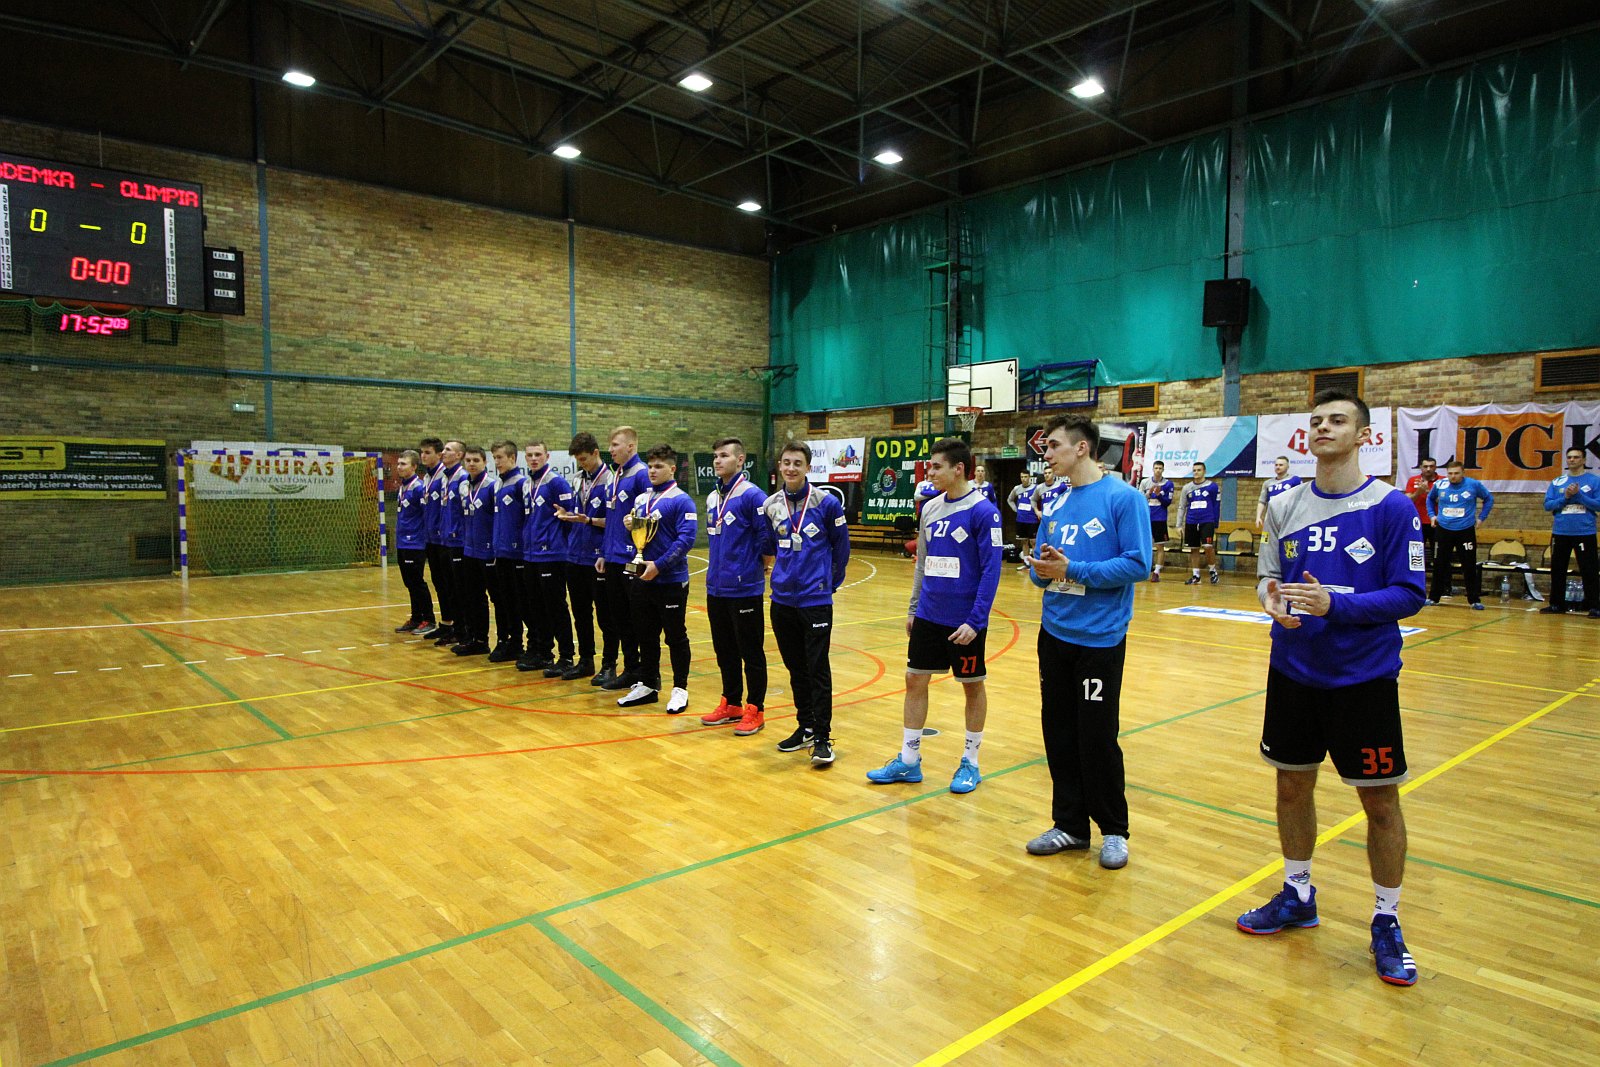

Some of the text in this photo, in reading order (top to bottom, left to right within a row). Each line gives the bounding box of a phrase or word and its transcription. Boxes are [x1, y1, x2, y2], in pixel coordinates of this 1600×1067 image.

[120, 180, 199, 208] OLIMPIA
[30, 208, 48, 232] 0
[130, 222, 147, 244] 0
[70, 256, 132, 286] 0:00
[1007, 364, 1013, 374] 4
[1155, 450, 1199, 461] naszą
[256, 460, 335, 476] HURAS
[0, 481, 36, 490] ateriały
[78, 481, 108, 489] chemia
[1449, 494, 1458, 502] 16
[934, 521, 950, 537] 27
[1061, 524, 1079, 545] 12
[1307, 526, 1338, 552] 35
[1463, 542, 1473, 550] 16
[1579, 543, 1584, 551] 1
[960, 655, 977, 674] 27
[1082, 678, 1103, 701] 12
[1361, 747, 1394, 775] 35
